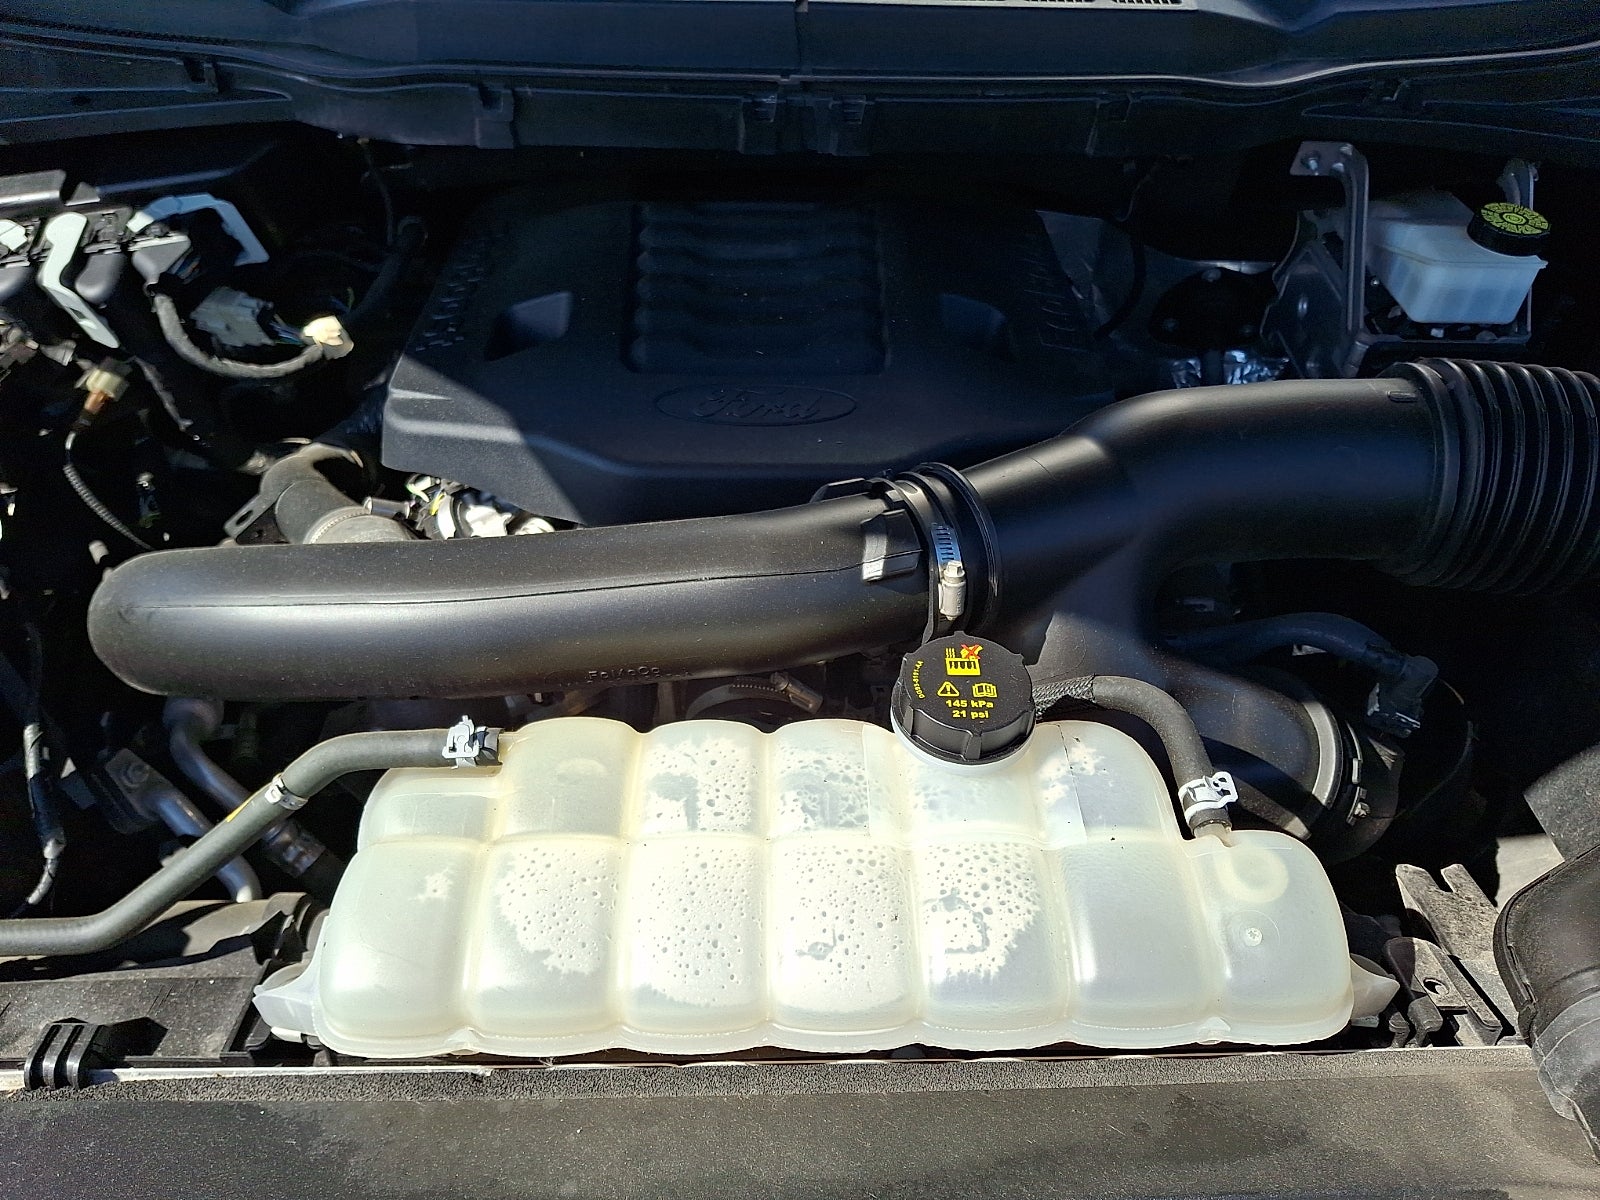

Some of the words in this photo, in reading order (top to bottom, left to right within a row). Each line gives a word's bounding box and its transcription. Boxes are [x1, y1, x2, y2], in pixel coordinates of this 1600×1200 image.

[693, 386, 822, 419] Ford
[945, 700, 968, 708] 145
[971, 700, 994, 708] kPa
[952, 710, 967, 718] 21
[971, 710, 989, 720] psi
